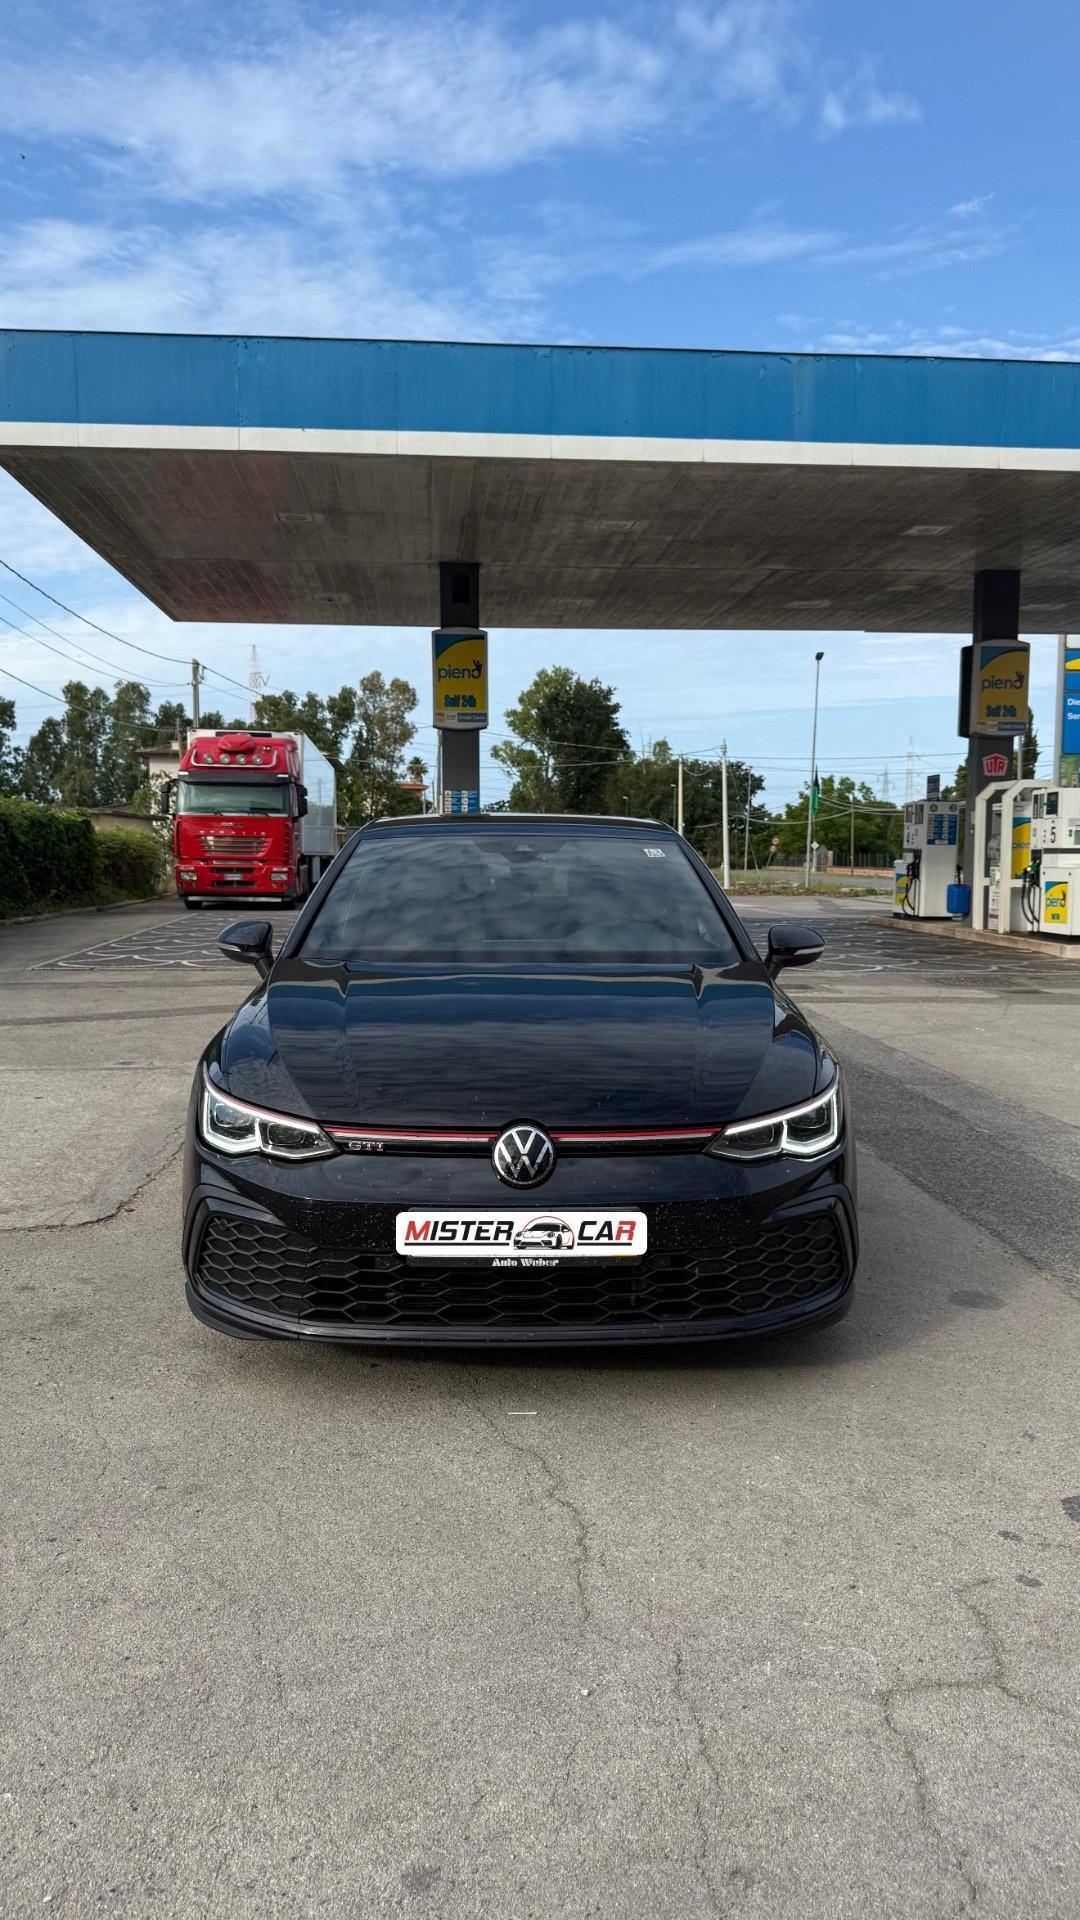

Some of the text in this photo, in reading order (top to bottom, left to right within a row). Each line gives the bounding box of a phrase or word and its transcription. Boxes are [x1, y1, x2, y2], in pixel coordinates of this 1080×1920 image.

[437, 660, 483, 682] pieno
[981, 671, 1024, 692] pieno
[1050, 826, 1056, 844] 5
[348, 1141, 385, 1152] GTI
[404, 1220, 637, 1241] MISTER CAR
[491, 1257, 560, 1268] Auto Weber
